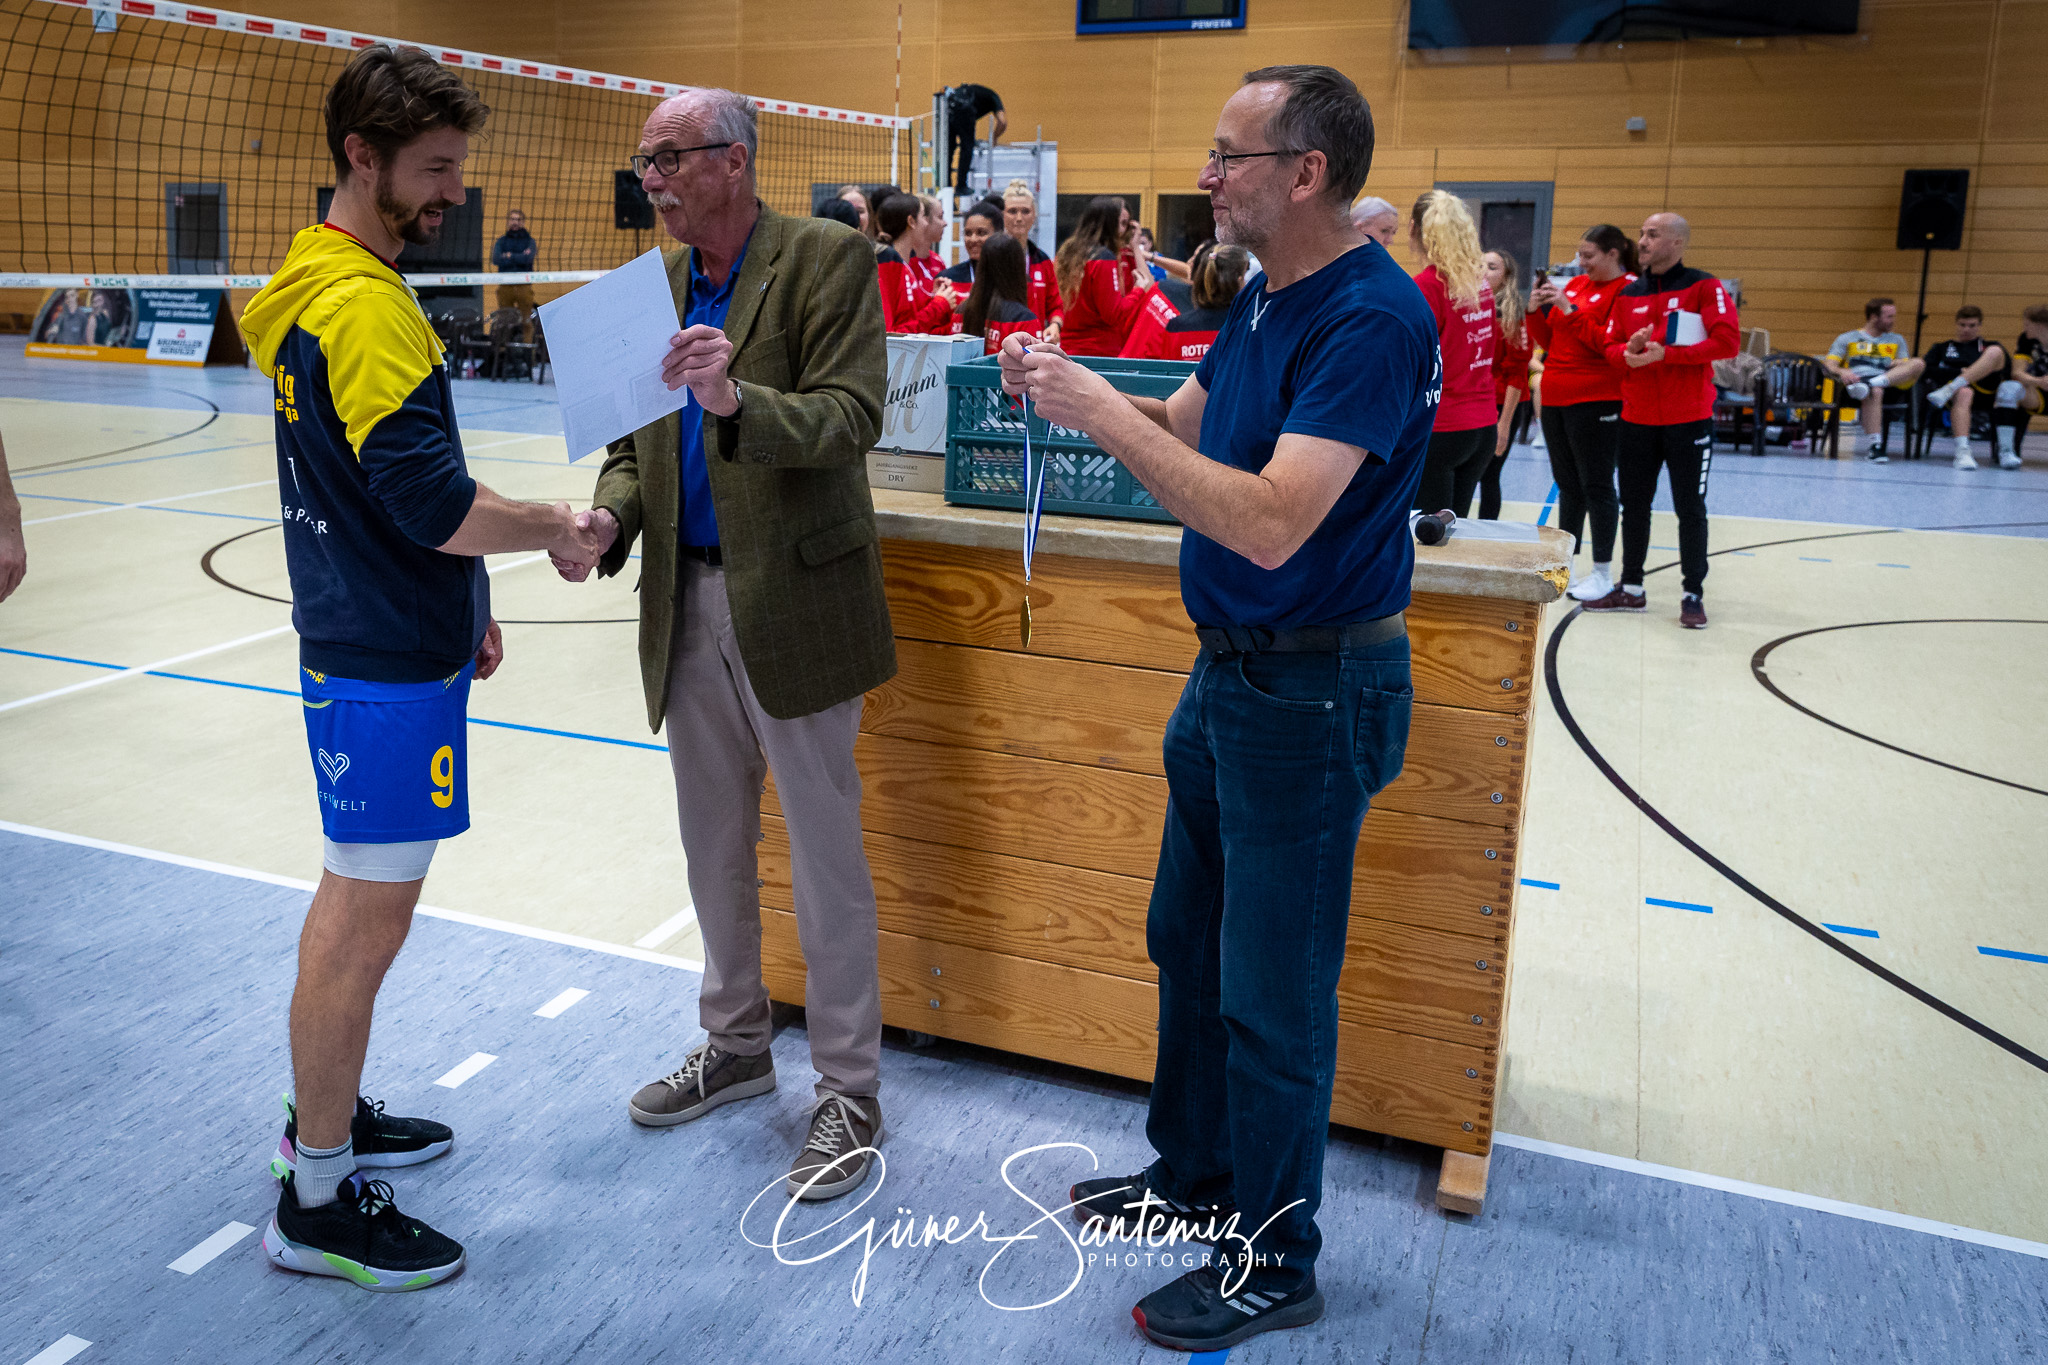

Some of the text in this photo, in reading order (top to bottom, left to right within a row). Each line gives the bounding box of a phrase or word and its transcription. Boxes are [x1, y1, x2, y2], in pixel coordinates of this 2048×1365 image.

[94, 277, 129, 287] FUCHS
[884, 373, 938, 408] umm
[888, 474, 906, 483] DRY
[430, 745, 454, 809] 9
